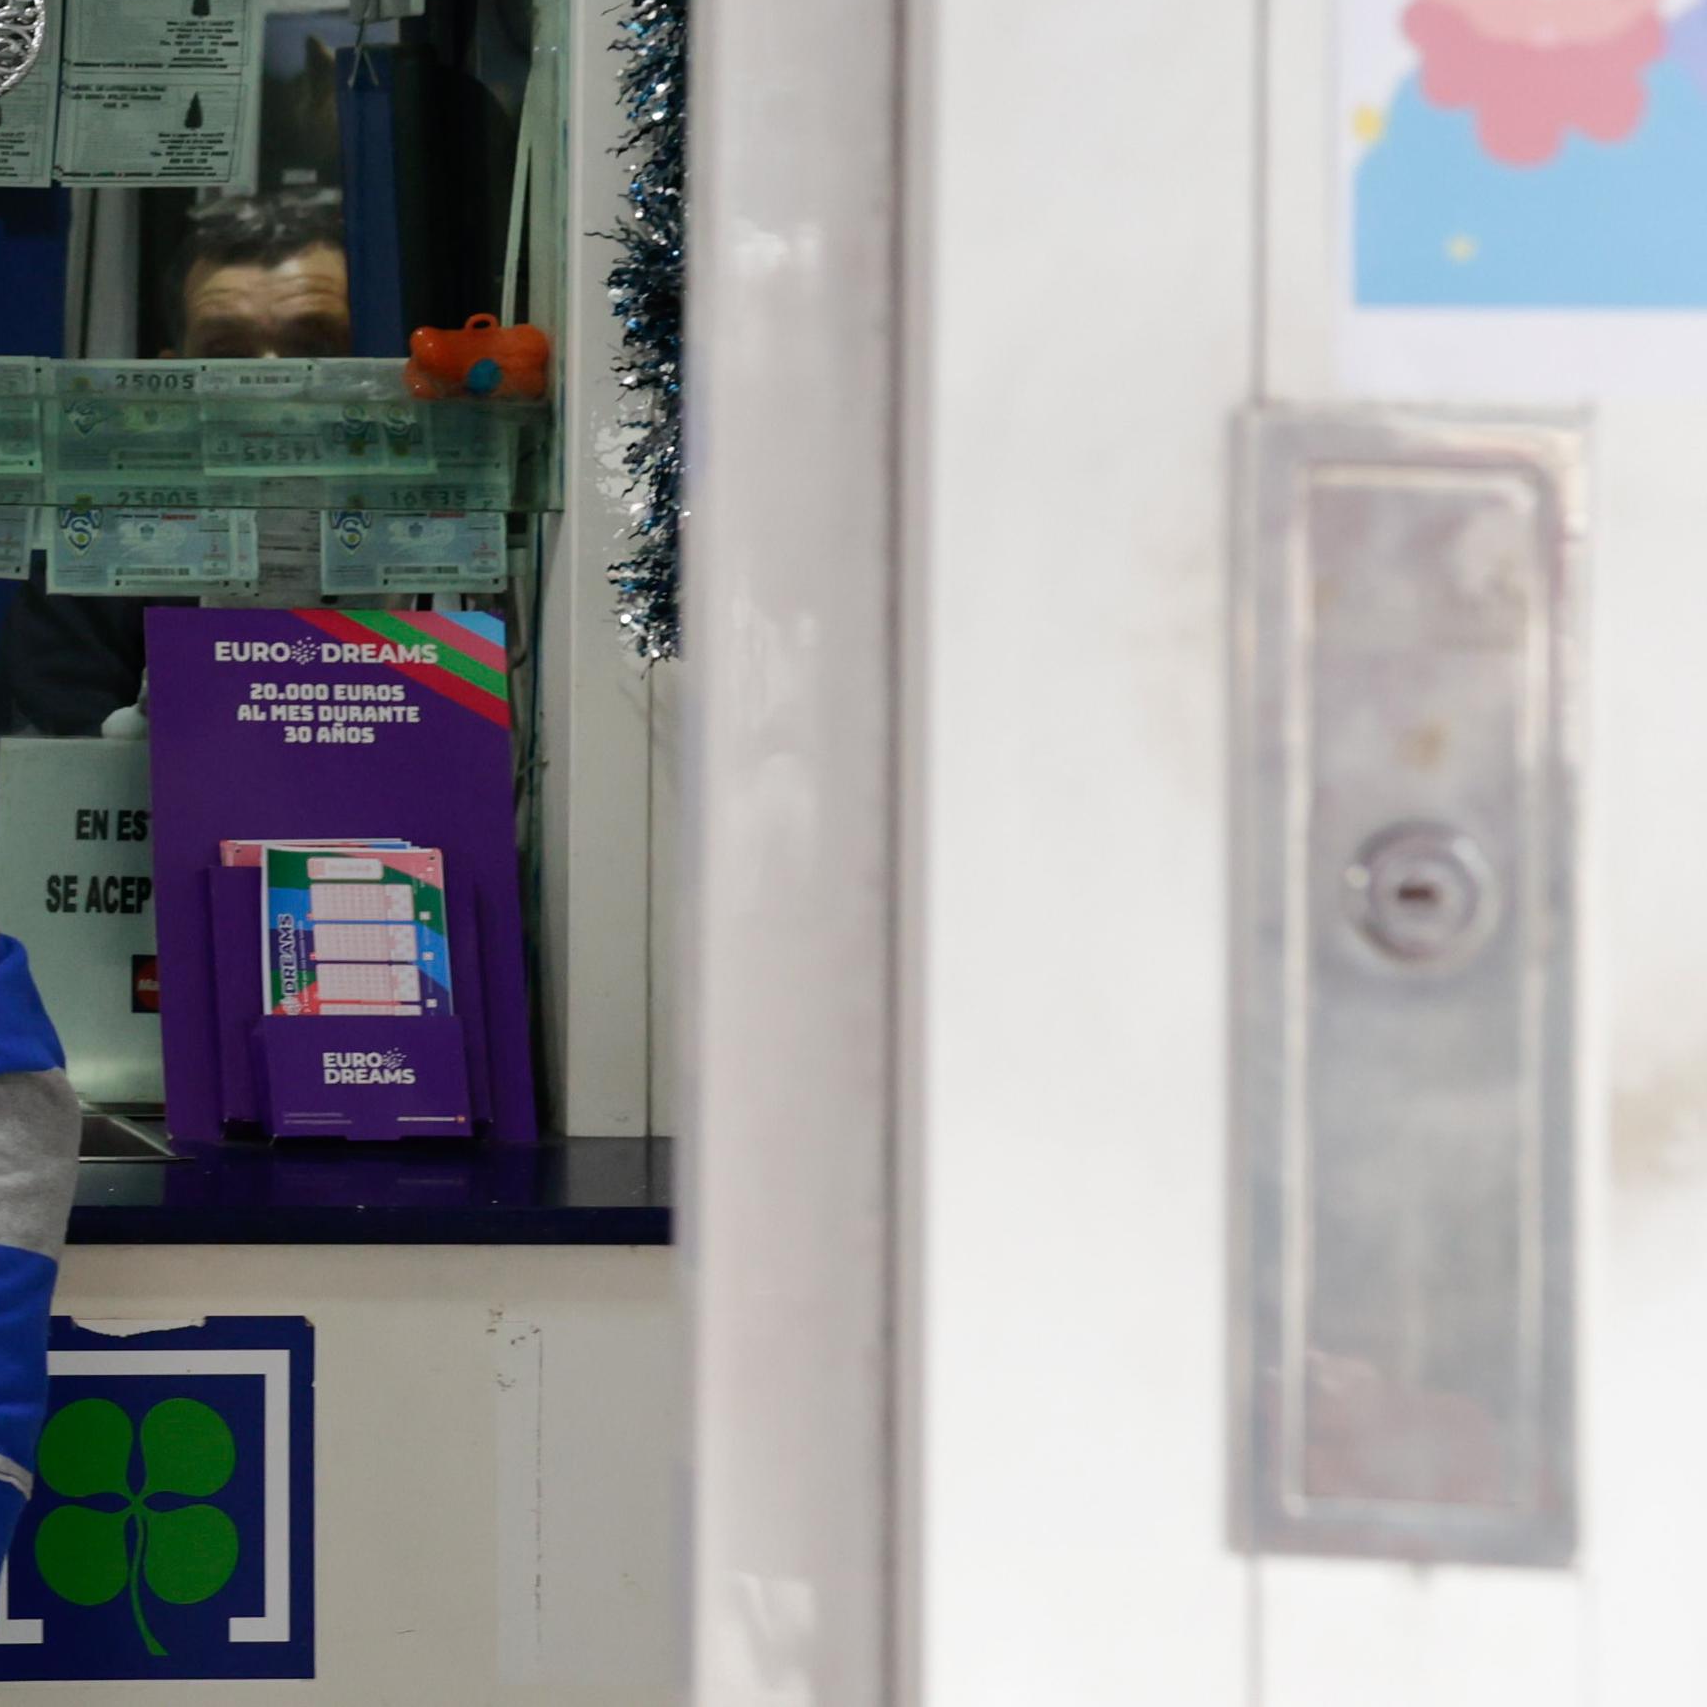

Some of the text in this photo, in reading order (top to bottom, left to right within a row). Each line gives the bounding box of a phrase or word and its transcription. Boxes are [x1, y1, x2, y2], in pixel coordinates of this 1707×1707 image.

[115, 373, 195, 390] 25005
[214, 641, 439, 664] EURO DREAMS
[250, 683, 406, 702] 20.000 EUROS
[237, 704, 421, 723] AL MES DURANTE
[284, 722, 376, 744] 30 AÑOS
[75, 809, 151, 841] EN ES
[45, 875, 78, 913] SE
[322, 1052, 384, 1068] EURO
[324, 1068, 416, 1085] DREAMS
